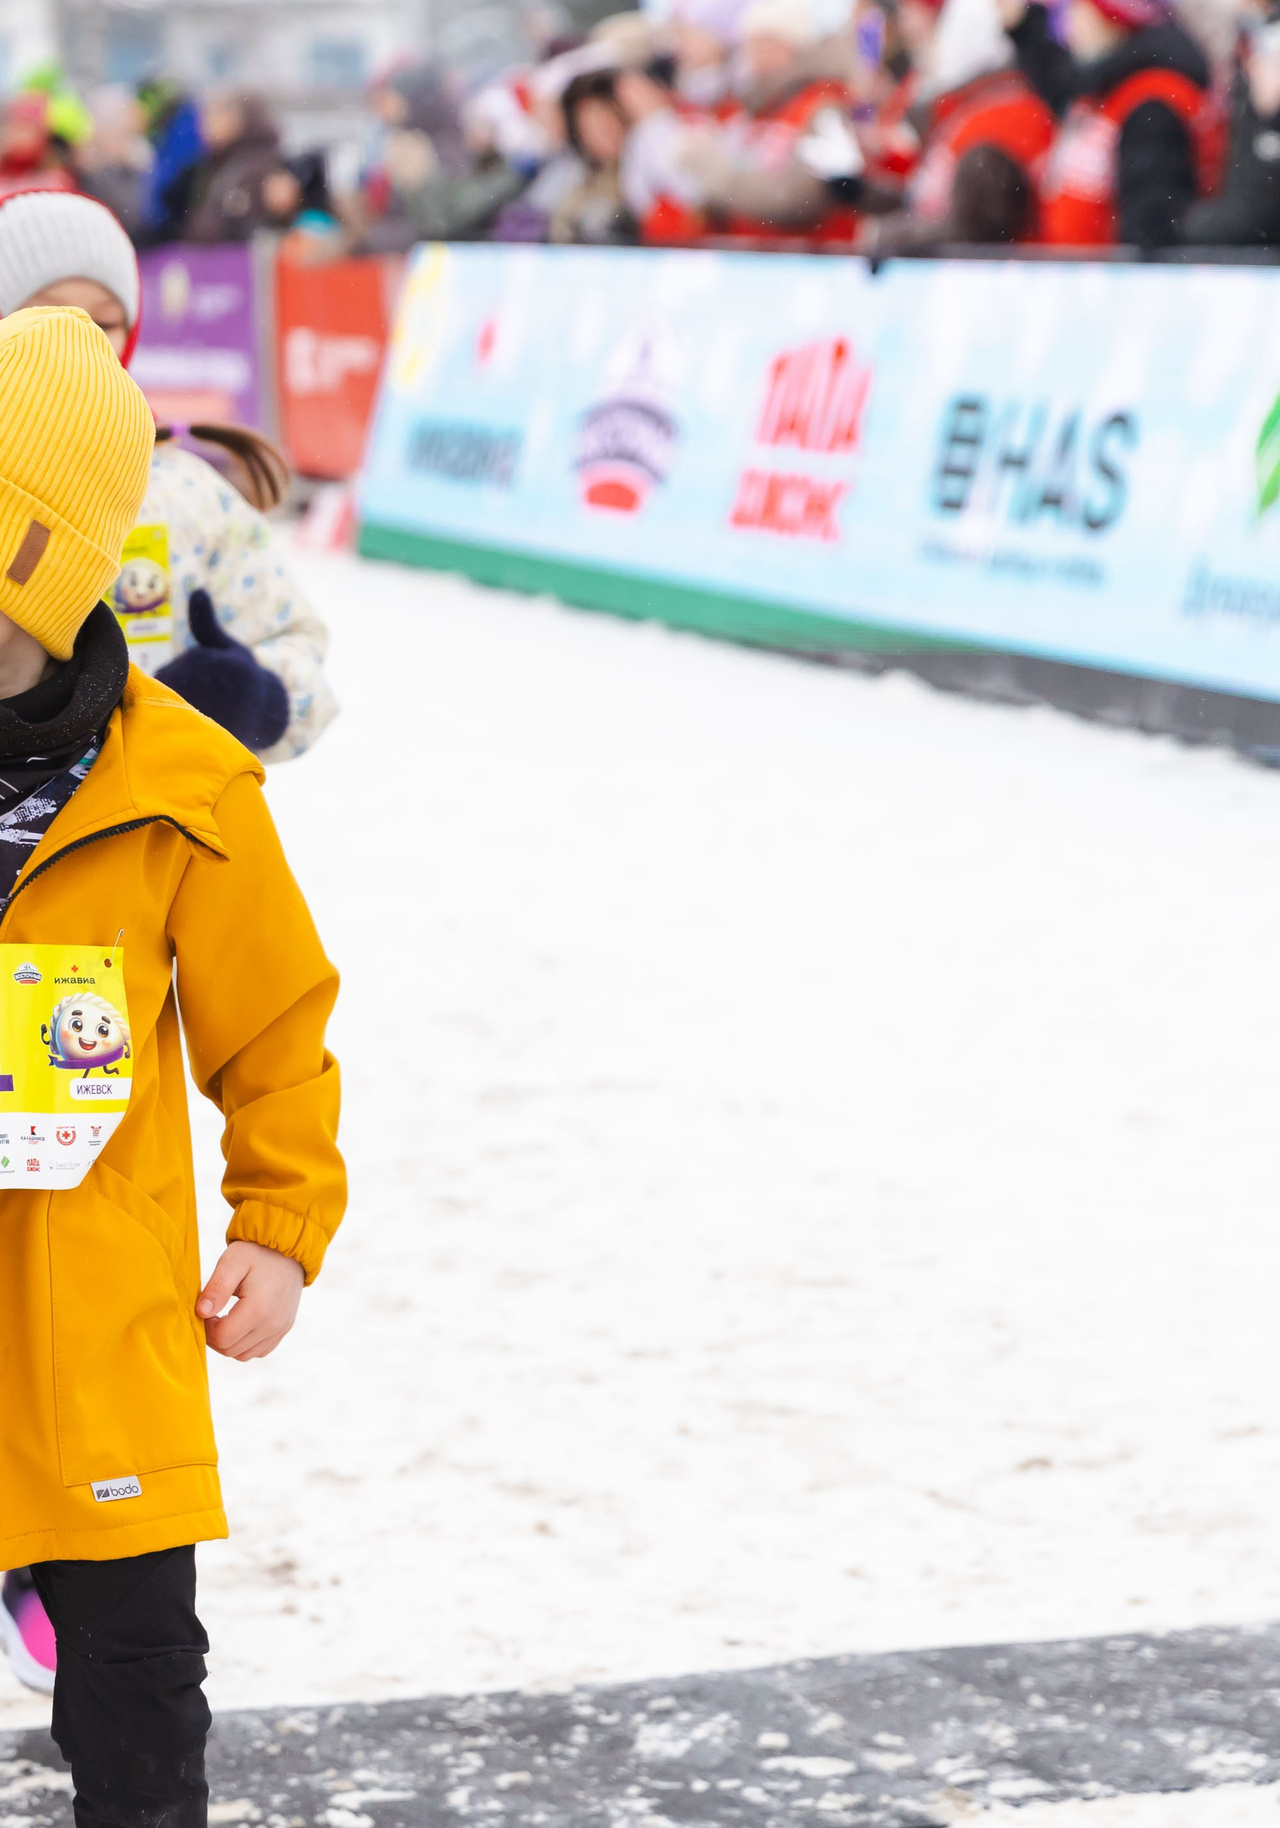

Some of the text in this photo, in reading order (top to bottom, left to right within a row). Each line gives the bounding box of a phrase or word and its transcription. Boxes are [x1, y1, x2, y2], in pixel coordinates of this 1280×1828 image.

[54, 977, 96, 985] ижавиа
[76, 1084, 113, 1095] ИЖЕВСК
[109, 1482, 139, 1497] bodo
